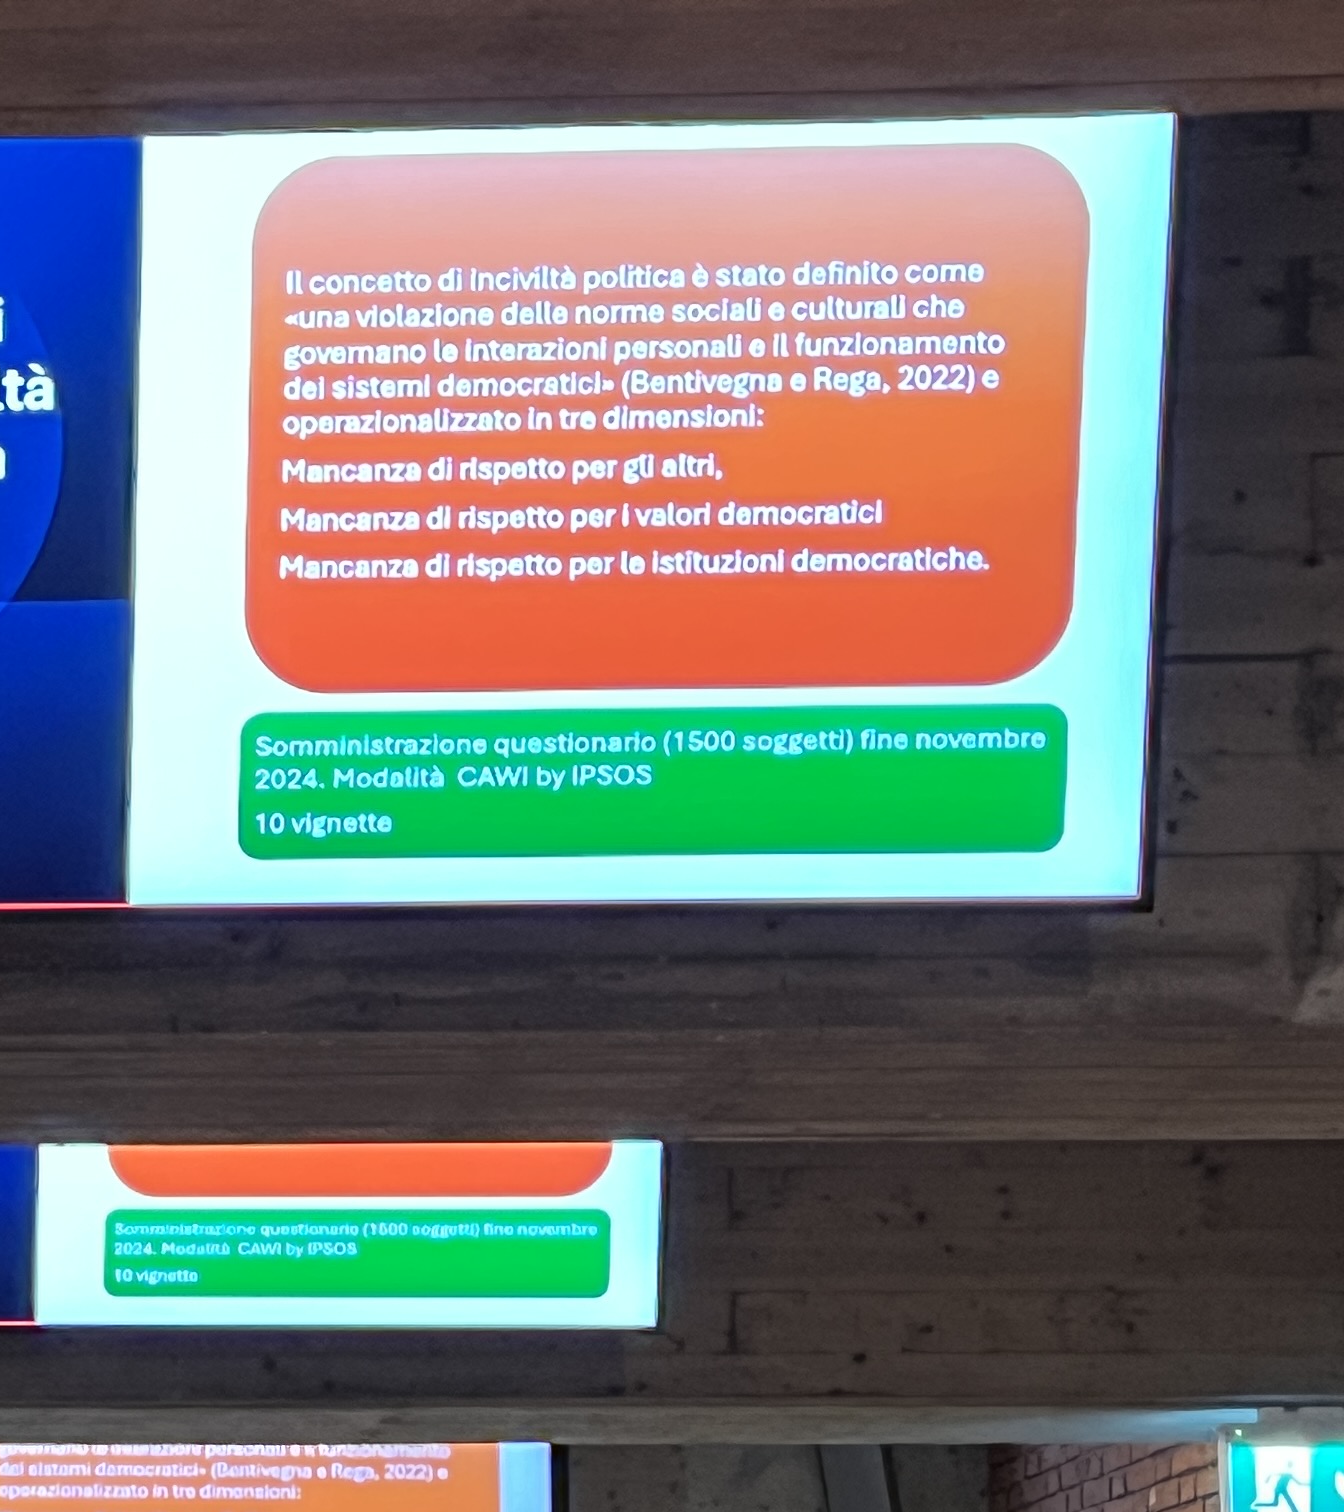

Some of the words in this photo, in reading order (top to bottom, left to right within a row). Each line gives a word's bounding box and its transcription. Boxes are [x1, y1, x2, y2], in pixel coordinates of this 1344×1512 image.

[286, 270, 303, 294] Il
[309, 269, 432, 294] concetto
[437, 267, 462, 292] di
[470, 265, 576, 291] inciviltà
[584, 264, 685, 294] politica
[692, 263, 708, 288] è
[715, 264, 785, 287] stato
[792, 261, 898, 286] definito
[905, 262, 984, 283] come
[356, 303, 494, 328] violazione
[501, 301, 568, 325] delle
[575, 304, 664, 324] norme
[671, 298, 762, 322] sociali
[768, 301, 785, 321] e
[791, 295, 906, 321] culturali
[912, 294, 965, 318] che
[283, 343, 426, 371] governano
[434, 338, 458, 363] le
[465, 337, 607, 362] interazioni
[614, 334, 742, 365] personali
[748, 338, 766, 358] e
[773, 333, 789, 357] il
[795, 331, 1005, 357] funzionamento
[283, 376, 325, 400] dei
[332, 375, 430, 399] sistemi
[621, 369, 782, 399] (Bentivegna
[790, 372, 806, 392] e
[813, 366, 891, 397] Rega,
[898, 364, 975, 394] 2022)
[982, 369, 1000, 388] e
[282, 408, 521, 439] operazionalizzato
[528, 407, 552, 431] in
[559, 409, 596, 430] tre
[603, 403, 764, 430] dimensioni:
[281, 459, 421, 483] Mancanza
[428, 457, 453, 481] di
[459, 456, 565, 485] rispetto
[572, 459, 617, 484] per
[623, 454, 654, 484] gli
[662, 453, 722, 480] altri,
[280, 507, 420, 532] Mancanza
[426, 506, 450, 530] di
[458, 506, 564, 534] rispetto
[570, 507, 616, 533] per
[622, 503, 629, 526] i
[634, 502, 710, 526] valori
[718, 499, 882, 525] democratici
[279, 555, 418, 579] Mancanza
[425, 553, 450, 578] di
[457, 553, 562, 582] rispetto
[569, 555, 615, 581] per
[621, 551, 645, 575] le
[653, 549, 784, 574] istituzioni
[791, 546, 990, 573] democratiche.
[255, 734, 486, 758] Somministrazione
[494, 731, 656, 758] questionario
[663, 730, 735, 756] (1500
[743, 729, 853, 755] soggetti)
[860, 728, 908, 750] fine
[915, 728, 1046, 750] novembre
[254, 768, 325, 790] 2024.
[333, 764, 445, 789] Modalità
[458, 765, 528, 787] CAWI
[537, 765, 566, 791] by
[572, 764, 652, 786] IPSOS
[255, 812, 284, 834] 10
[291, 811, 393, 838] vignette
